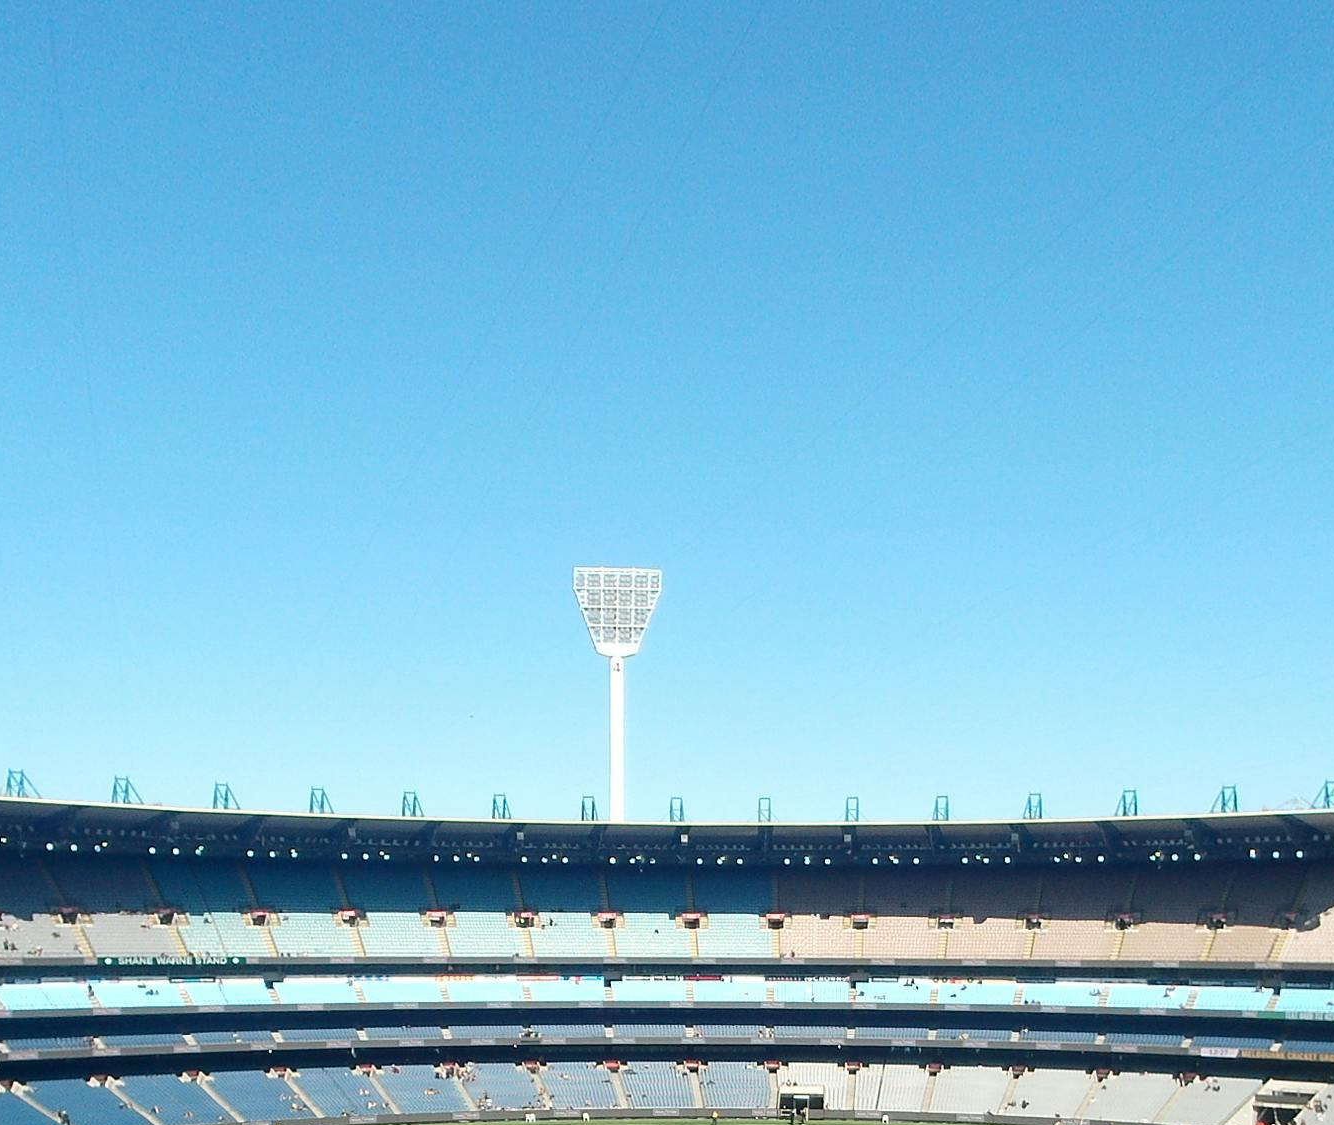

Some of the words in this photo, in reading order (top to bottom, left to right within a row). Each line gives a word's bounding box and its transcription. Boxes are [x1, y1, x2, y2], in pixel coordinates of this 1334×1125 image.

[118, 957, 153, 965] SHANE
[156, 956, 192, 965] WARNE
[196, 956, 228, 965] STAND
